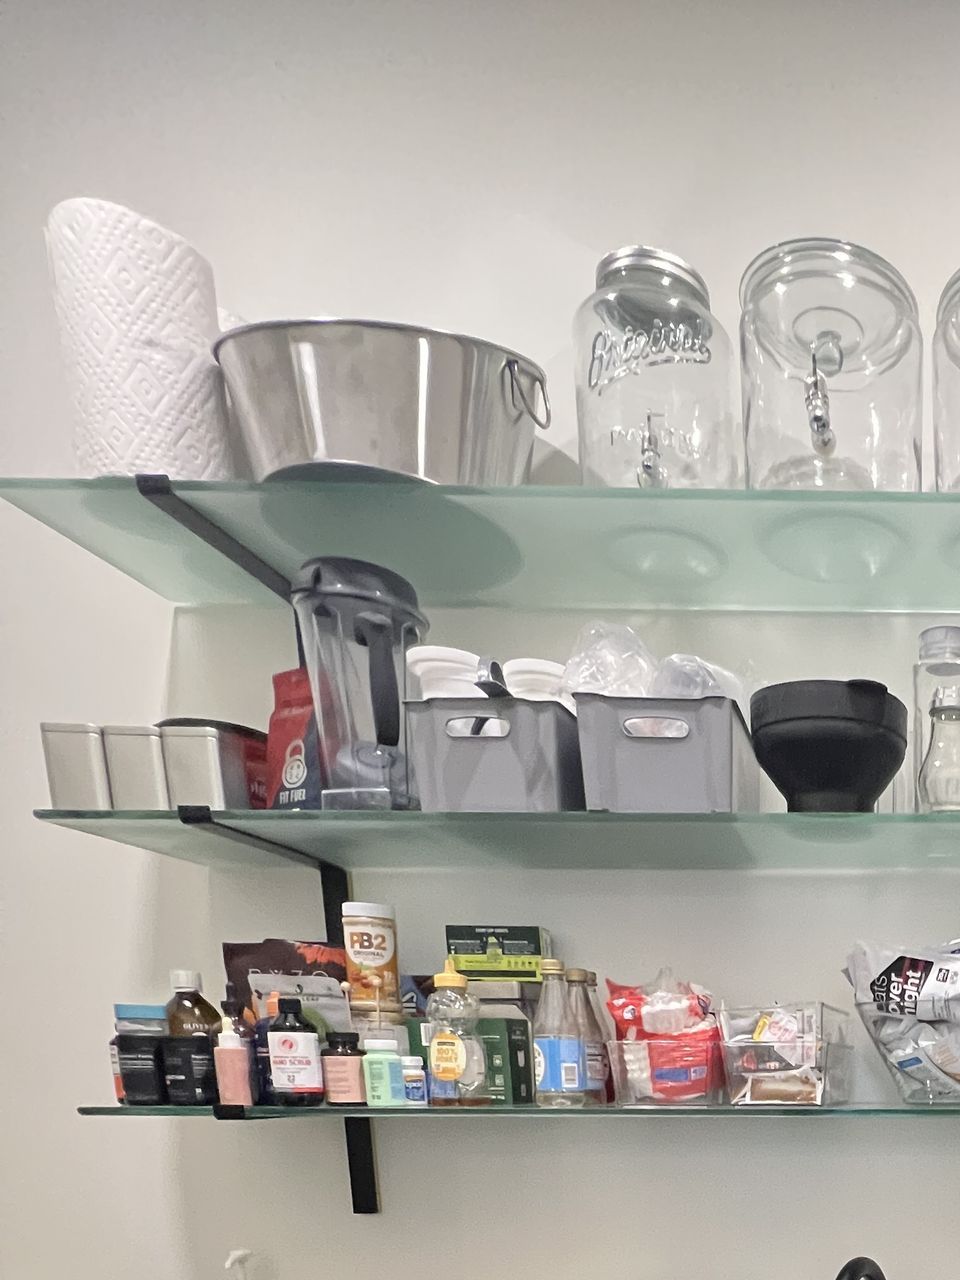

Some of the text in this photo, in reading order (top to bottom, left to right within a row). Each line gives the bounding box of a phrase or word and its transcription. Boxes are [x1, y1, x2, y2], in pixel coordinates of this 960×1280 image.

[290, 789, 306, 802] FUEL
[350, 932, 387, 951] PB2
[889, 972, 903, 1014] over
